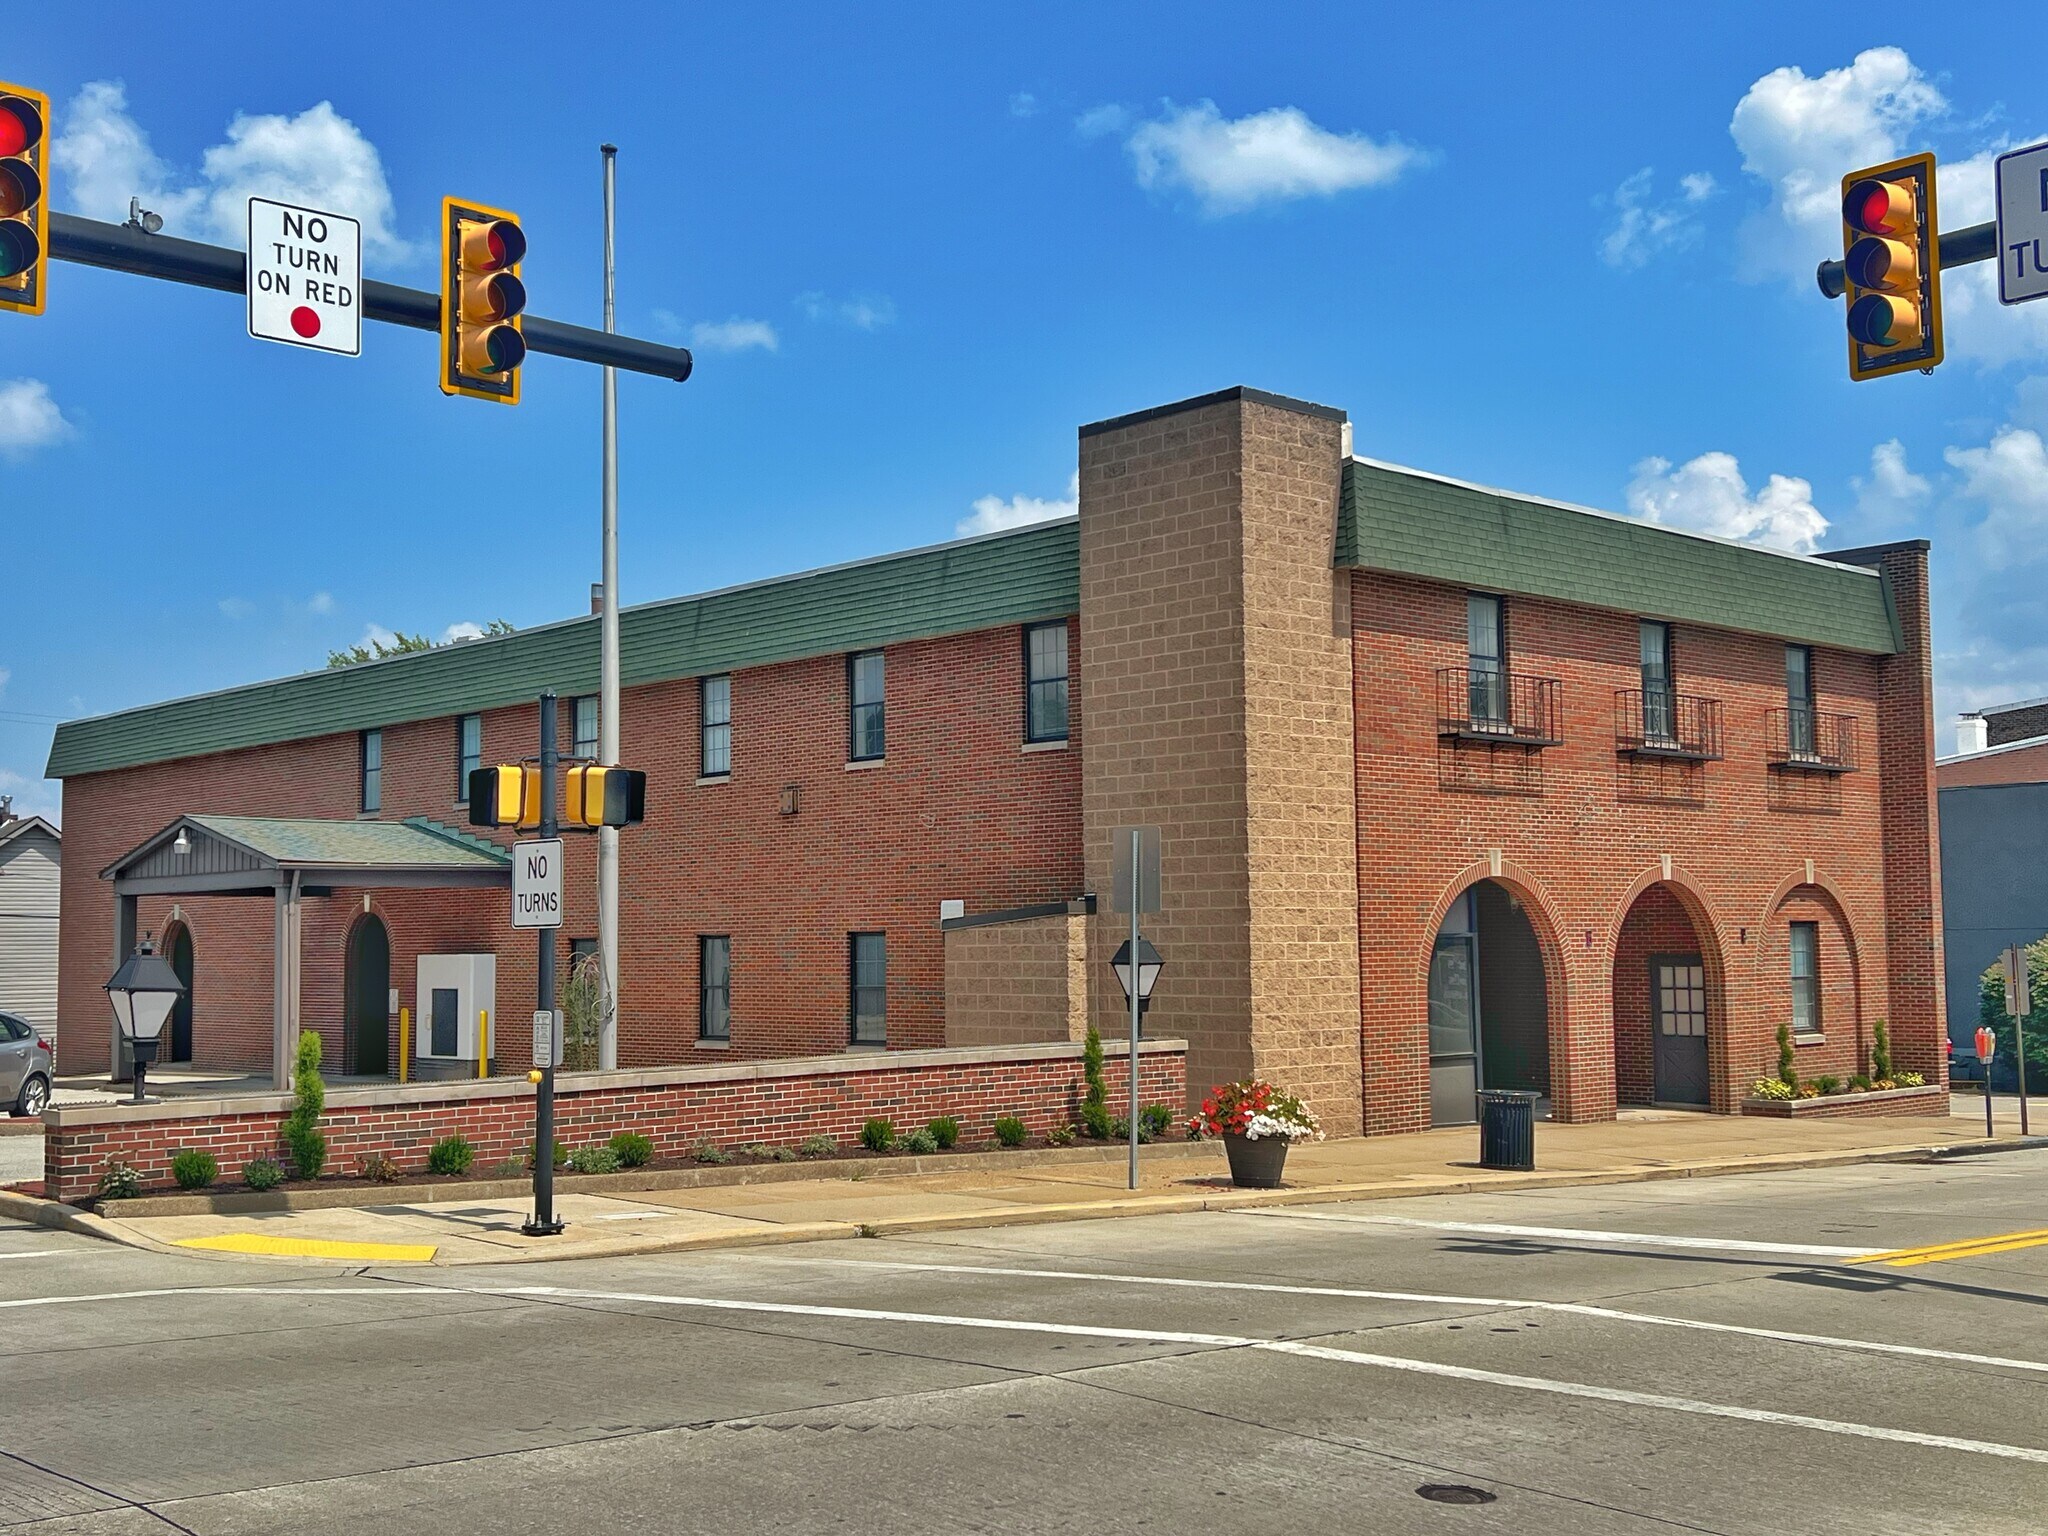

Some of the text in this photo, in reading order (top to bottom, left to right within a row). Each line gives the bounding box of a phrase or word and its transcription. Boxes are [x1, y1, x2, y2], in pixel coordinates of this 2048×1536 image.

[283, 211, 328, 243] NO
[272, 242, 338, 276] TURN
[258, 269, 352, 307] ON RED
[527, 855, 547, 879] NO
[518, 891, 558, 913] TURNS
